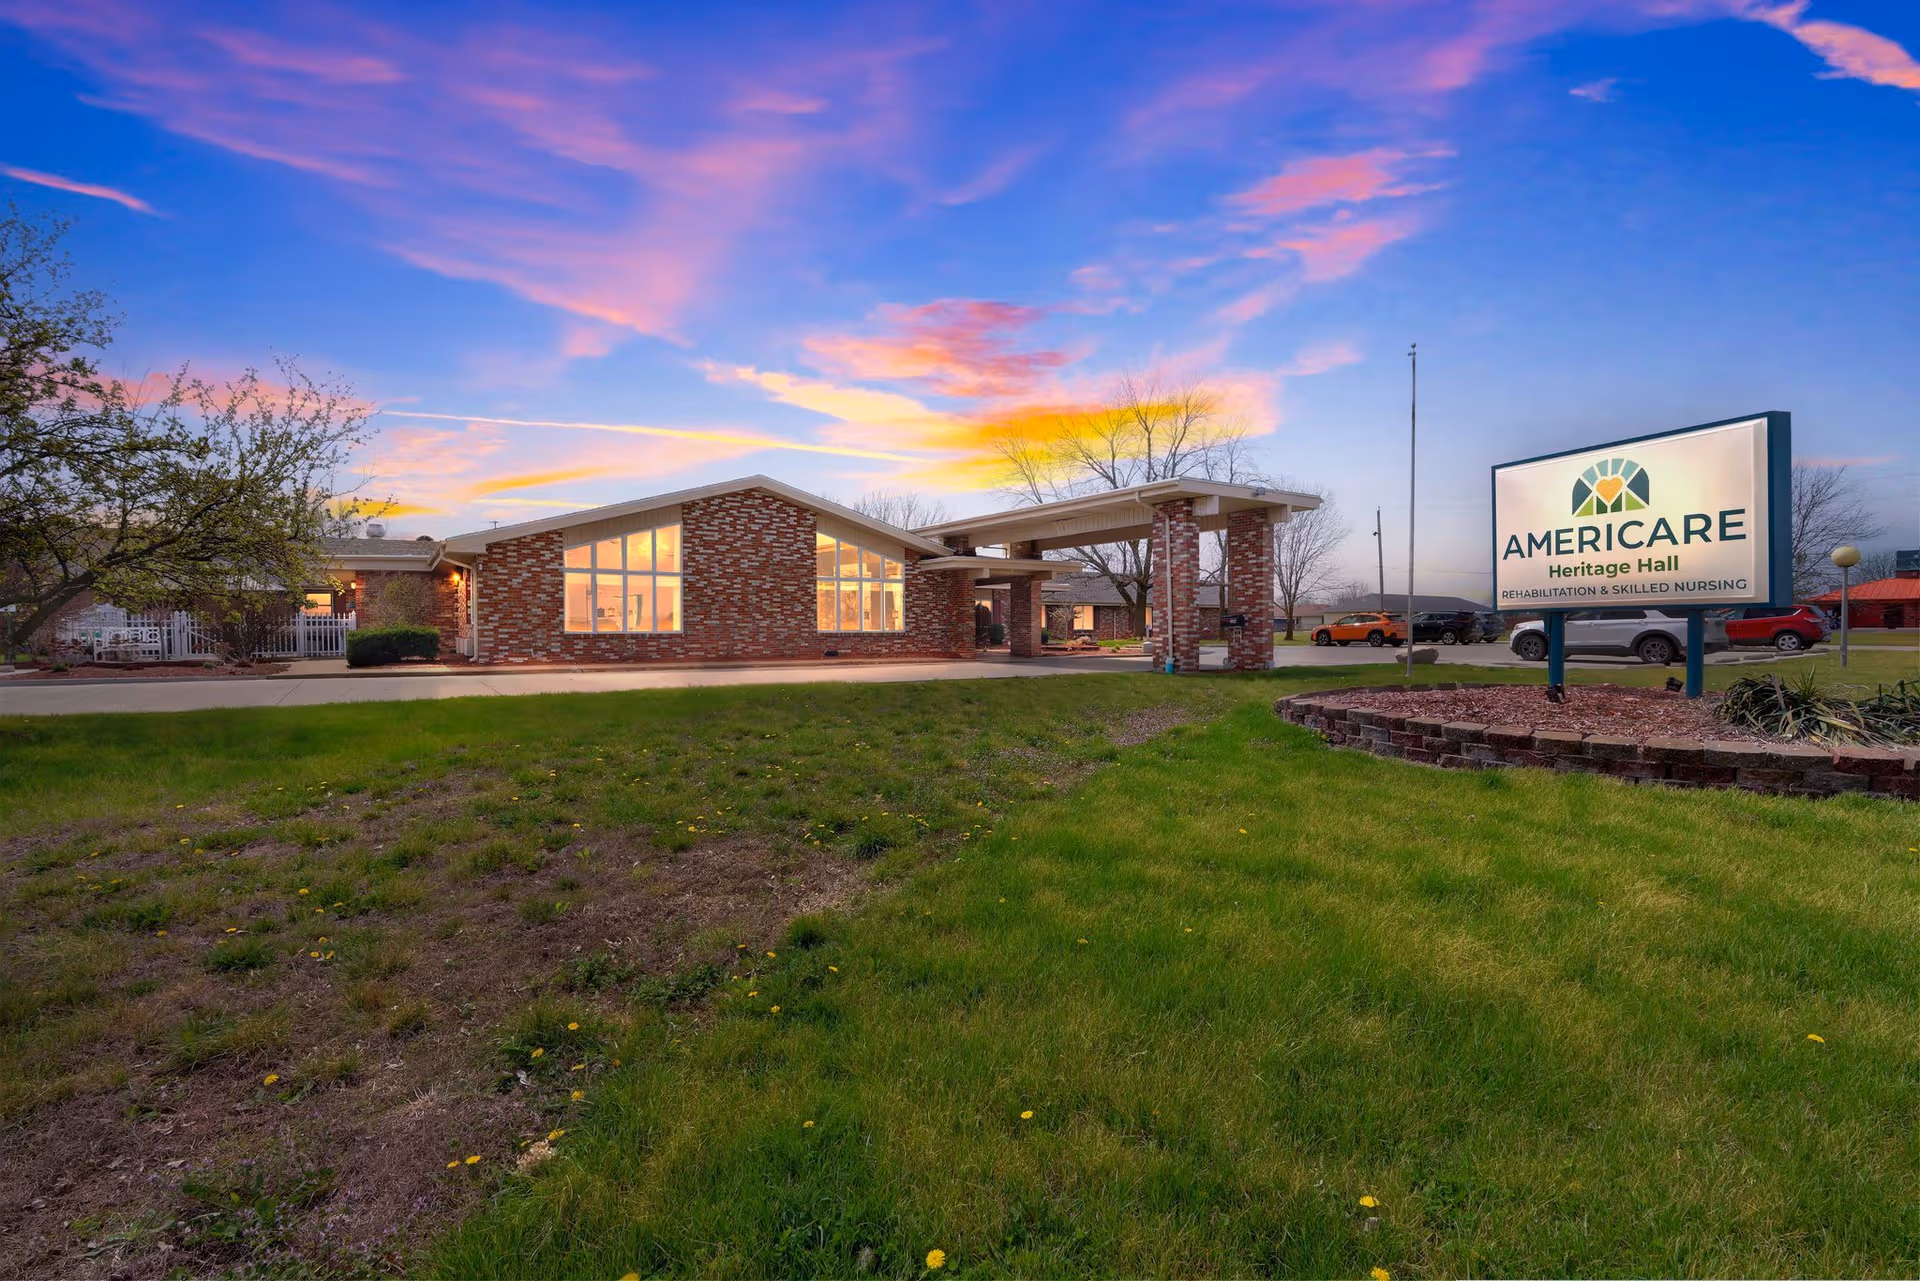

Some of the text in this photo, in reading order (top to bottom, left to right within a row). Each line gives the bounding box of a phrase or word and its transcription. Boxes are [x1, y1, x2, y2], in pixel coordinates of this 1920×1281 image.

[1502, 508, 1747, 560] AMERICARE
[1548, 555, 1679, 579] Heritage Hall
[1502, 578, 1747, 599] REHABILITATION & SKILLED NURSING
